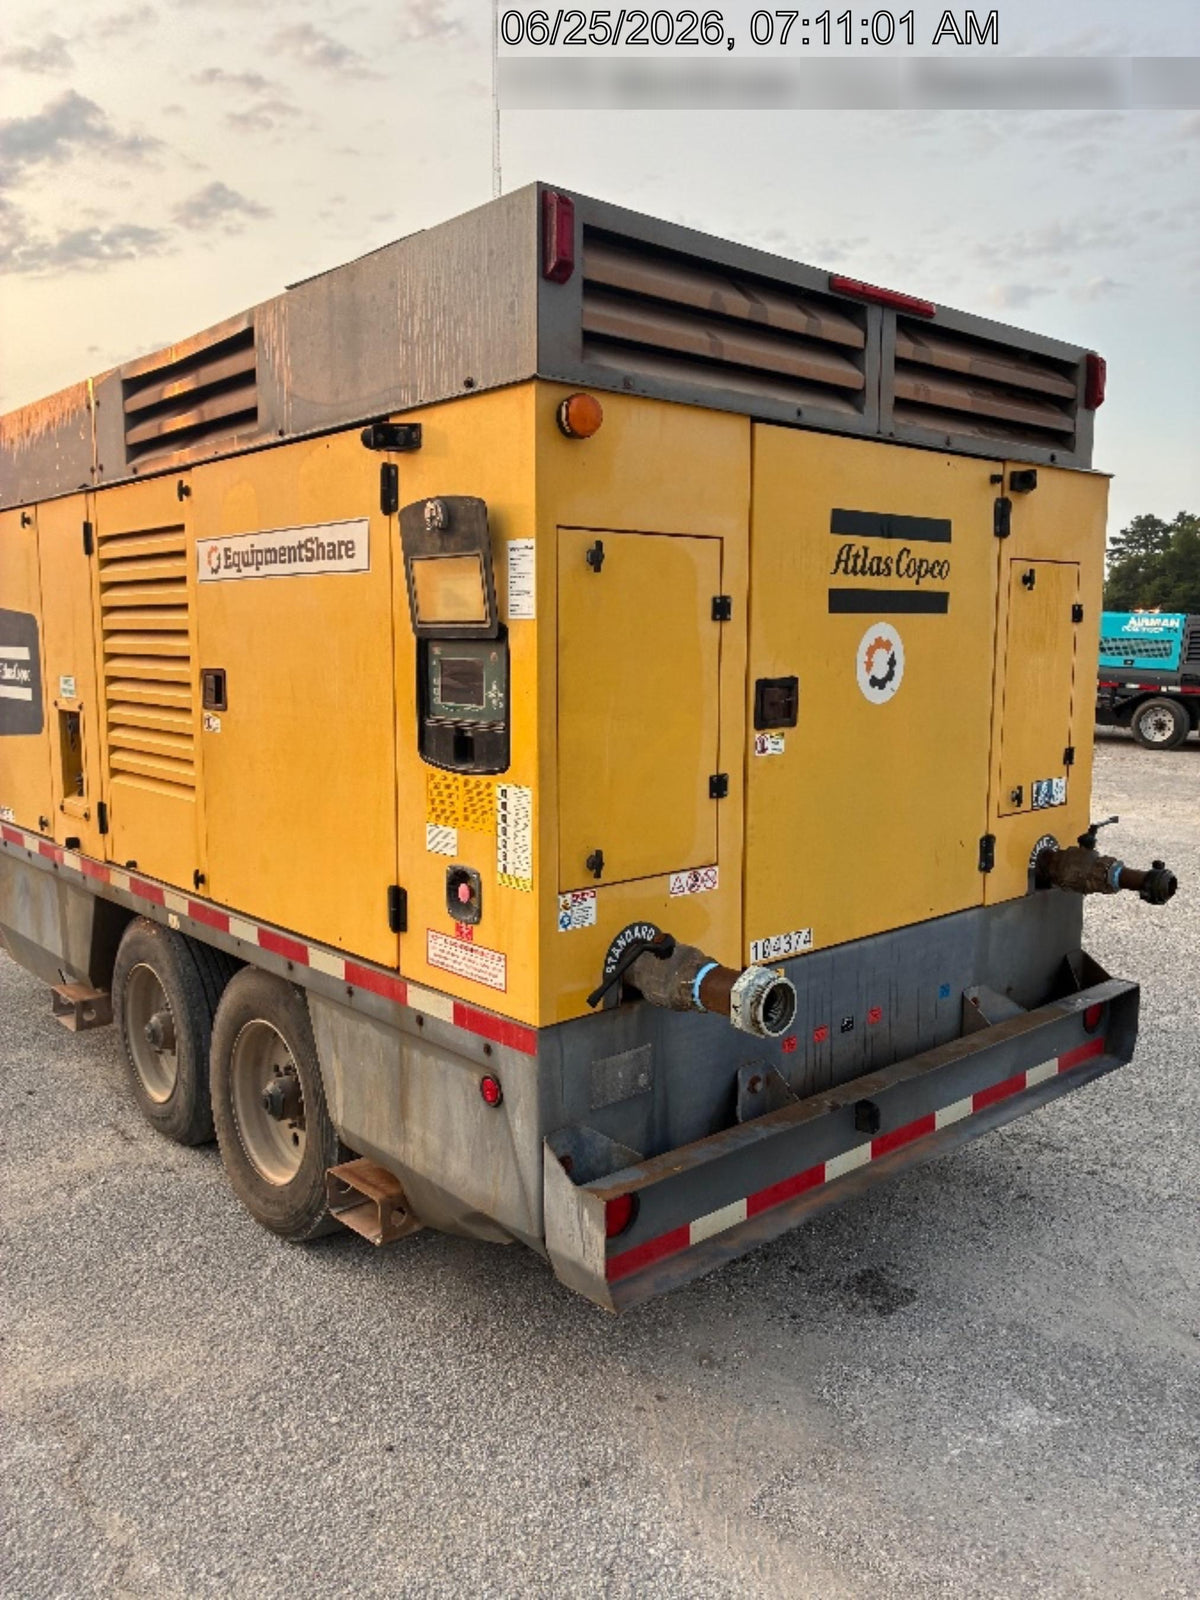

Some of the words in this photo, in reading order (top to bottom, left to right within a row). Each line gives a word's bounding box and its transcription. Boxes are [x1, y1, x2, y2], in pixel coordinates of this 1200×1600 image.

[223, 536, 356, 573] EquipmentShare
[829, 543, 894, 577] Atlas
[895, 546, 951, 586] Copco
[605, 925, 656, 974] STANDARD
[751, 927, 812, 961] 104374
